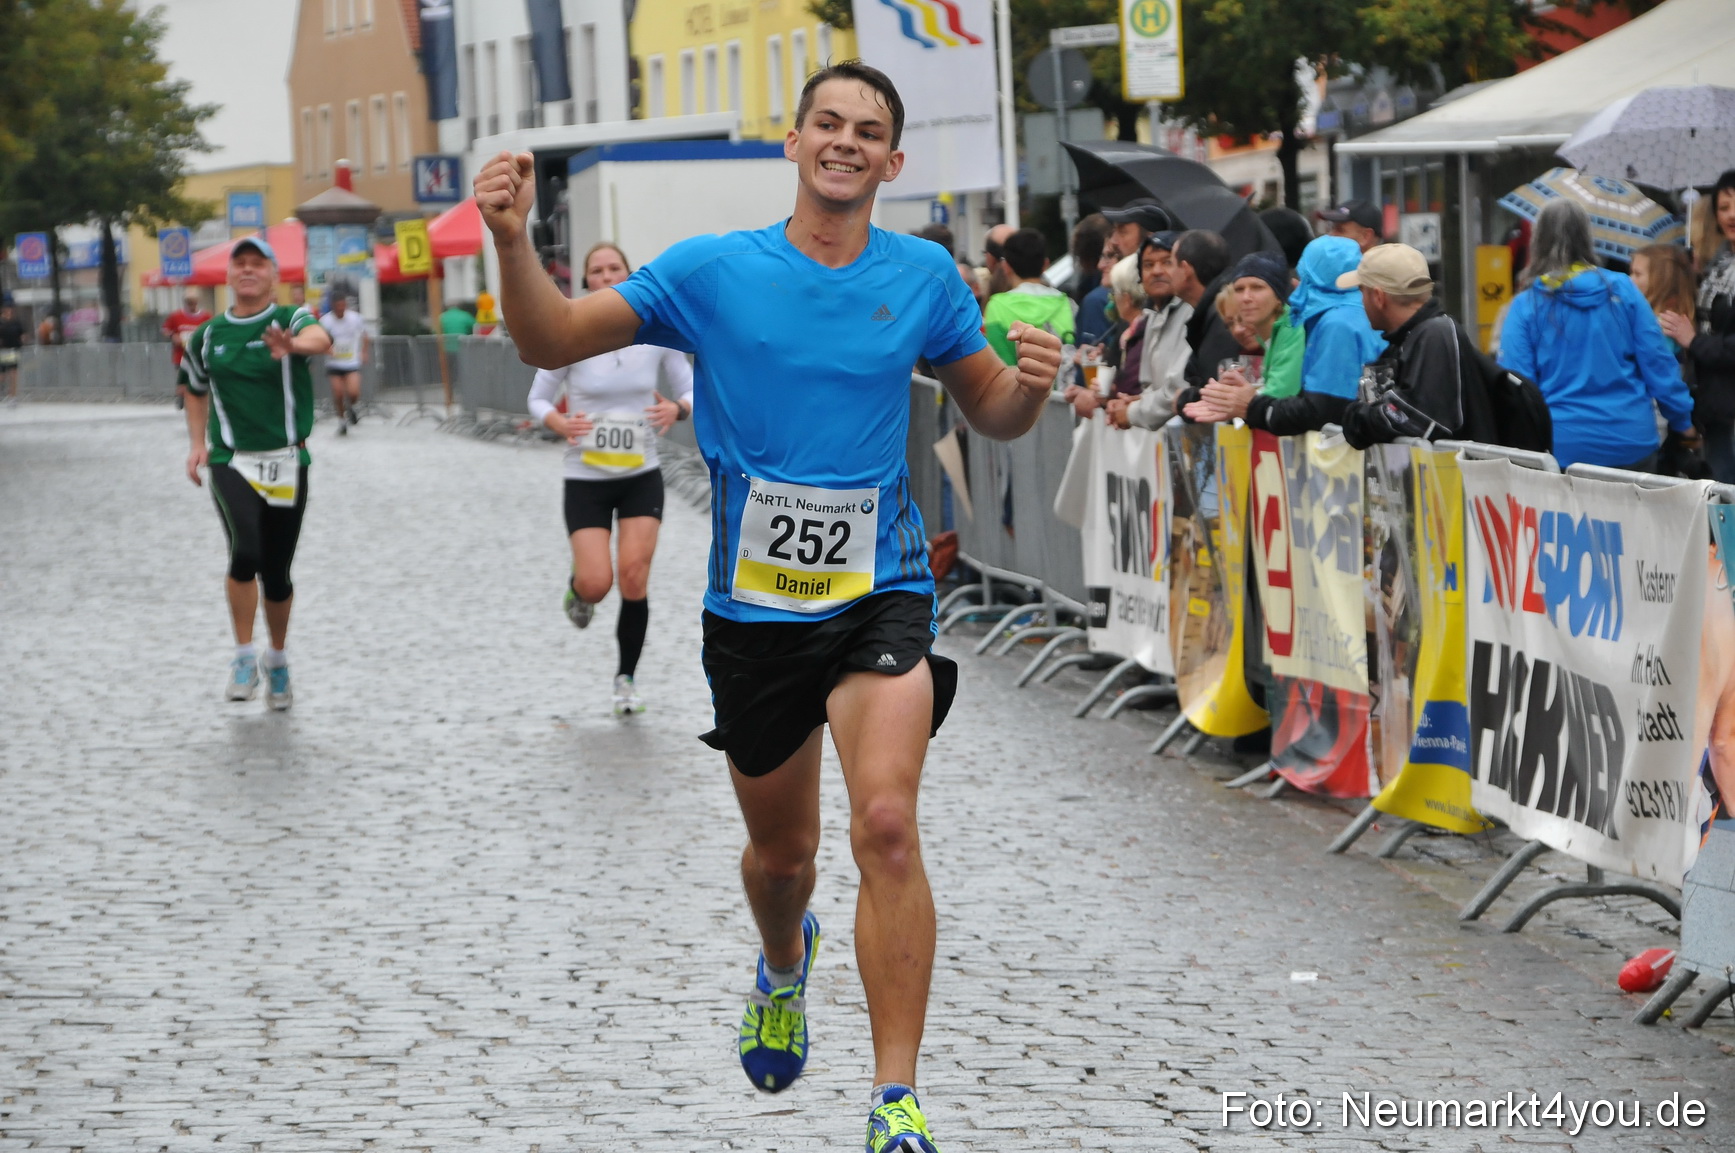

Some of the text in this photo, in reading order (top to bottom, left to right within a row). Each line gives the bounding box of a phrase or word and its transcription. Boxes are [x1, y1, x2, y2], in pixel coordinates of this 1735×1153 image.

[405, 235, 422, 259] D
[595, 426, 634, 449] 600
[750, 489, 856, 514] PARTL Neumarkt
[767, 514, 851, 565] 252
[742, 549, 749, 558] D
[775, 572, 831, 596] Daniel
[1625, 780, 1676, 821] 92318
